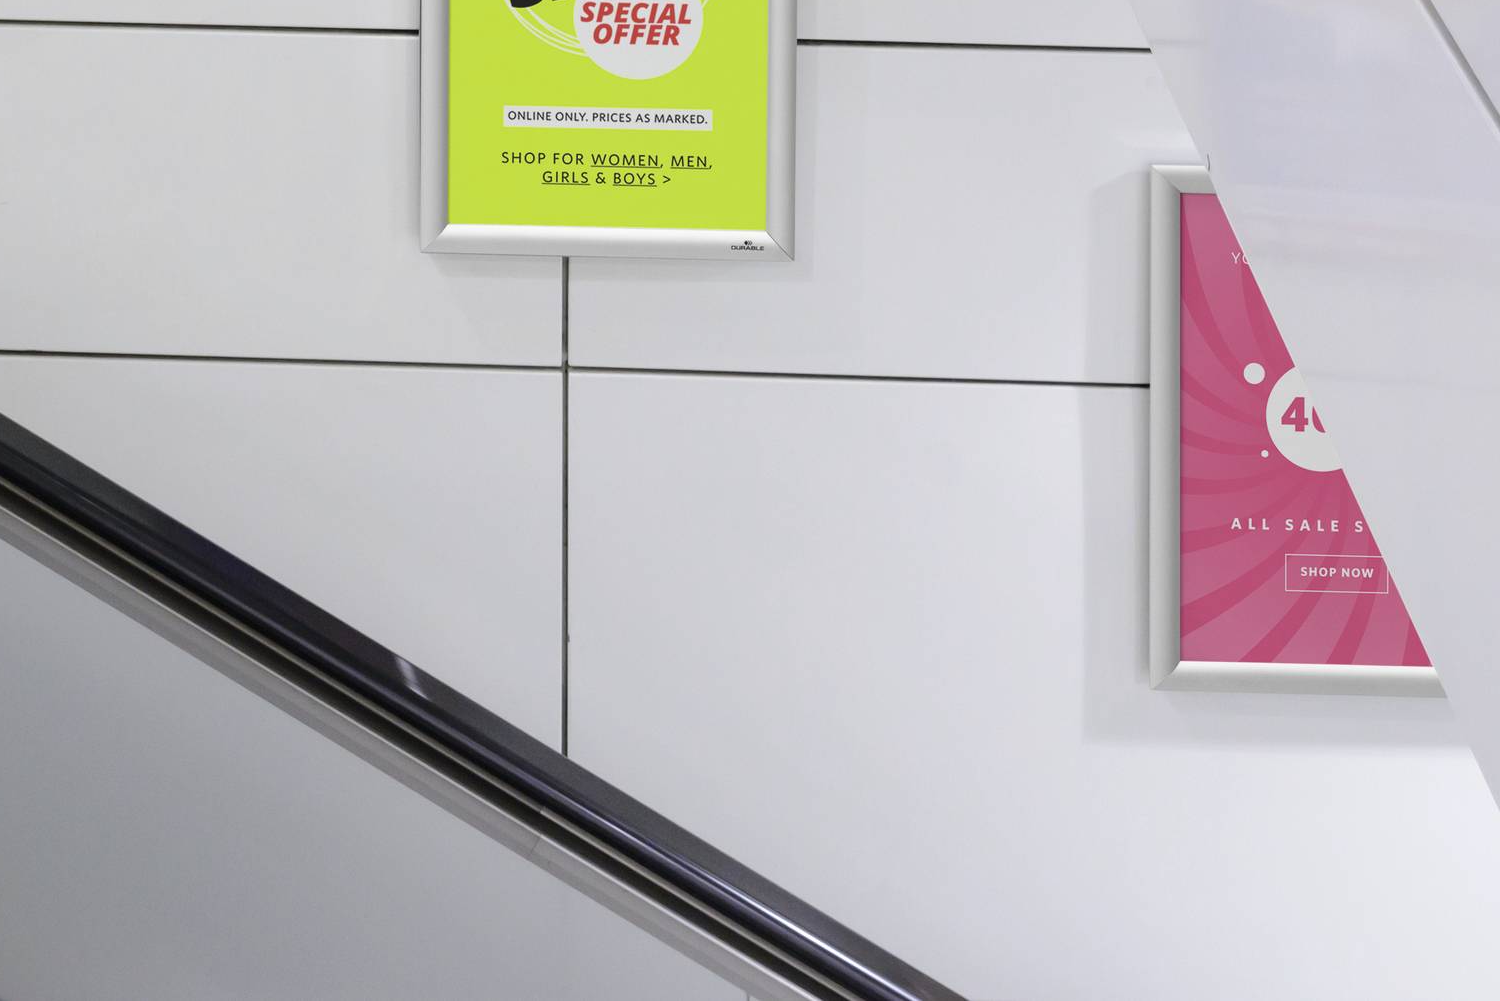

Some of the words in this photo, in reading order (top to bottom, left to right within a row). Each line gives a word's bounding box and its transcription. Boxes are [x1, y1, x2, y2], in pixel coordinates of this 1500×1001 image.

[580, 1, 692, 25] SPECIAL
[593, 23, 680, 46] OFFER
[507, 110, 552, 122] ONLINE
[554, 111, 589, 122] ONLY.
[592, 112, 632, 123] PRICES
[635, 113, 651, 124] AS
[654, 113, 708, 125] MARKED.
[502, 152, 545, 164] SHOP
[554, 153, 583, 165] FOR
[591, 154, 663, 168] WOMEN,
[671, 156, 712, 169] MEN,
[542, 171, 590, 185] GIRLS
[596, 172, 606, 184] &
[613, 172, 657, 186] BOYS
[730, 244, 766, 252] DURABLE
[1231, 518, 1269, 530] ALL
[1285, 519, 1338, 531] SALE
[1300, 566, 1337, 578] SHOP
[1341, 567, 1374, 580] NOW
